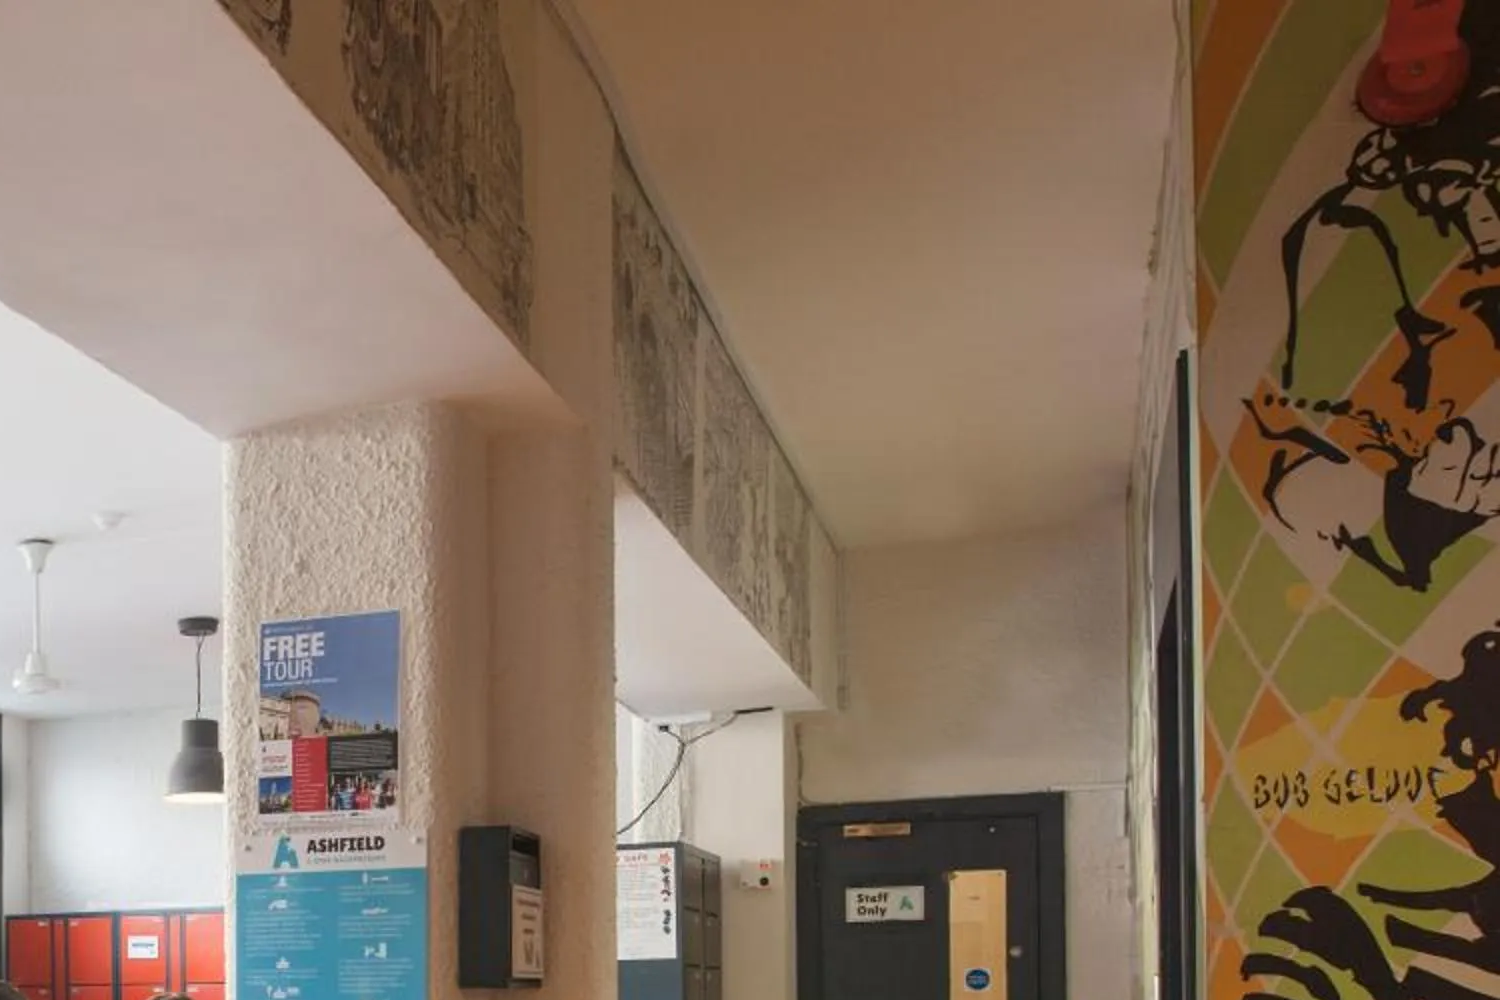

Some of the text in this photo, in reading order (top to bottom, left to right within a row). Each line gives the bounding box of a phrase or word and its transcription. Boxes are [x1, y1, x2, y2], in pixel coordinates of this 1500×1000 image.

[263, 631, 325, 660] FREE
[263, 659, 313, 681] TOUR
[1254, 771, 1310, 809] BOB
[307, 836, 385, 853] ASHFIELD
[857, 892, 889, 902] Staff
[857, 905, 887, 917] Only
